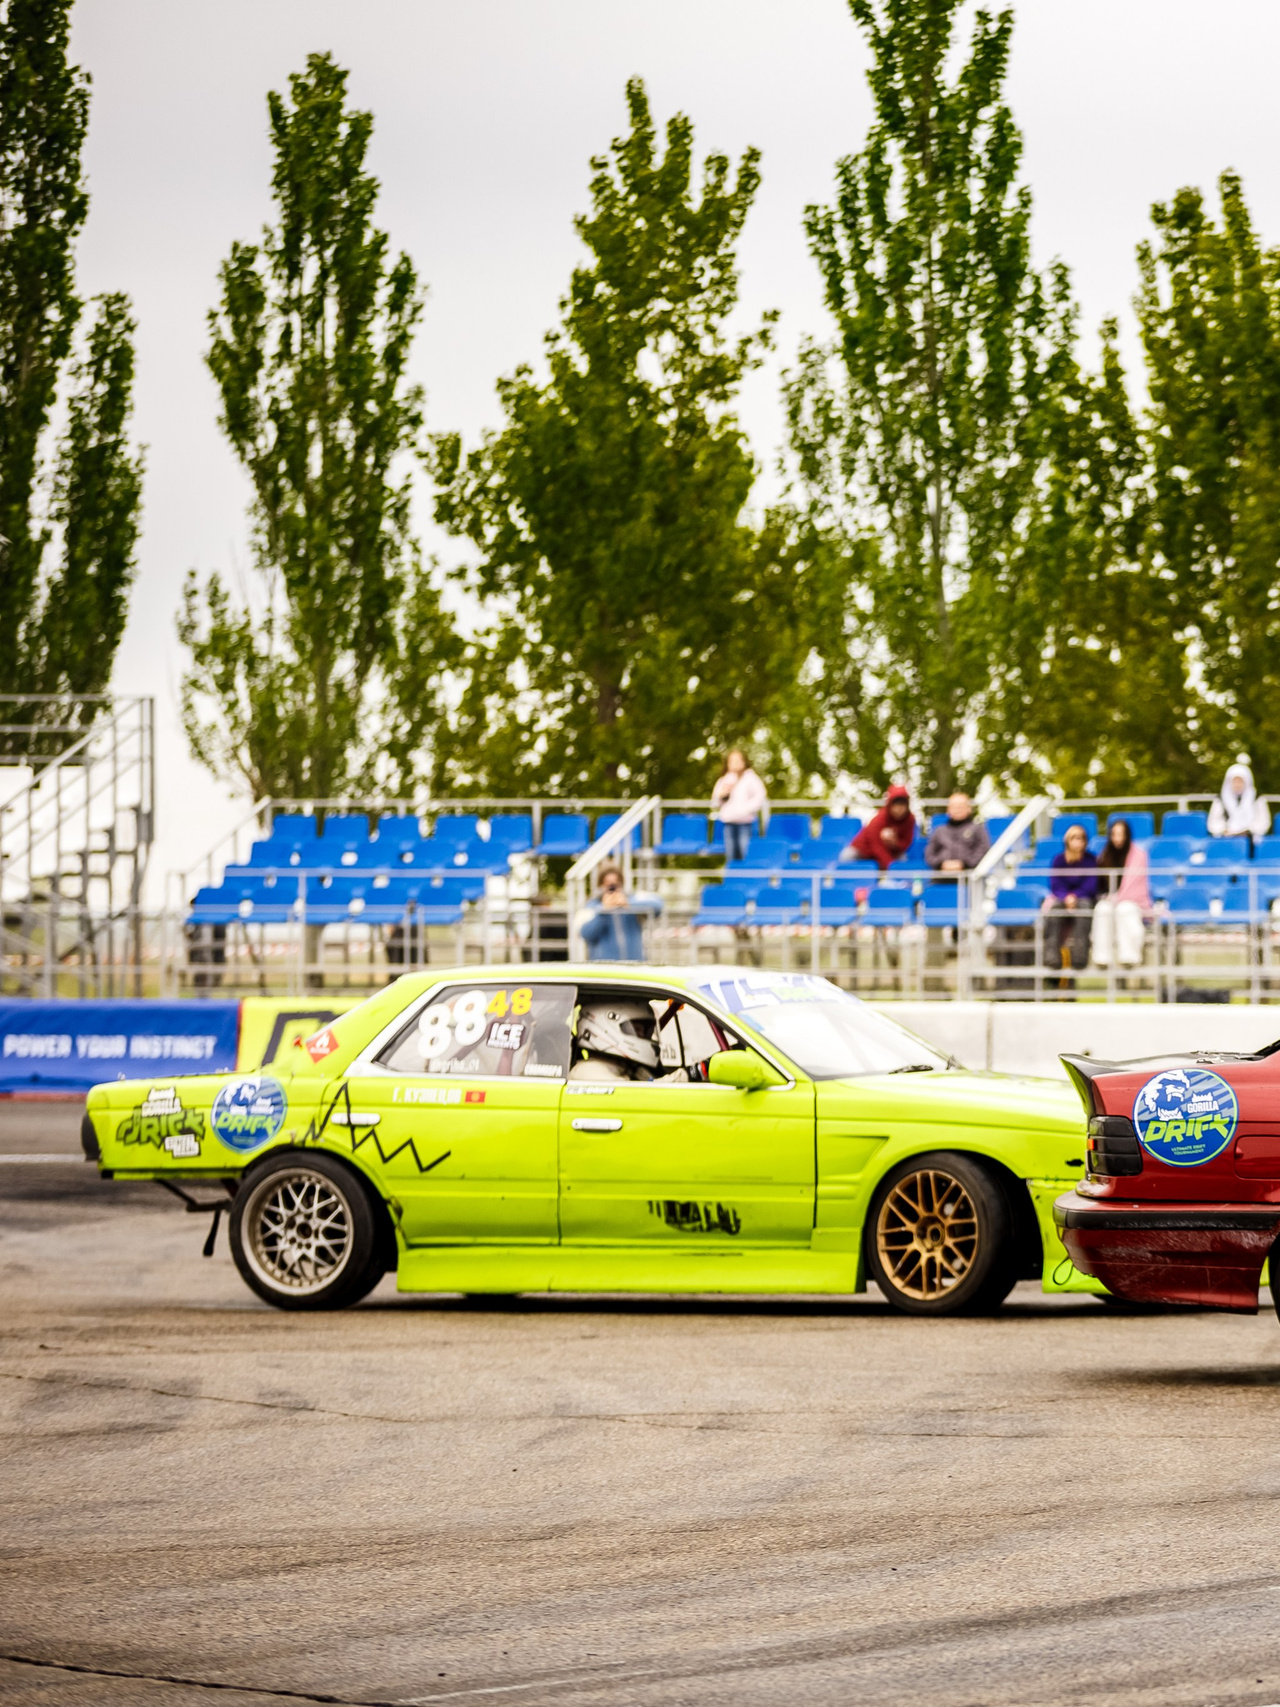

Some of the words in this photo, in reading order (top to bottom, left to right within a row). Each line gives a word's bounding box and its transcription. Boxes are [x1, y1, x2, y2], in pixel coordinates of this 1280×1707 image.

[486, 988, 533, 1018] 48
[418, 990, 487, 1059] 88
[490, 1022, 524, 1042] ICE
[4, 1034, 72, 1058] POWER
[76, 1034, 127, 1059] YOUR
[130, 1035, 218, 1059] INSTINCT
[1187, 1100, 1219, 1114] GORILLA
[1144, 1113, 1230, 1143] DRIFT
